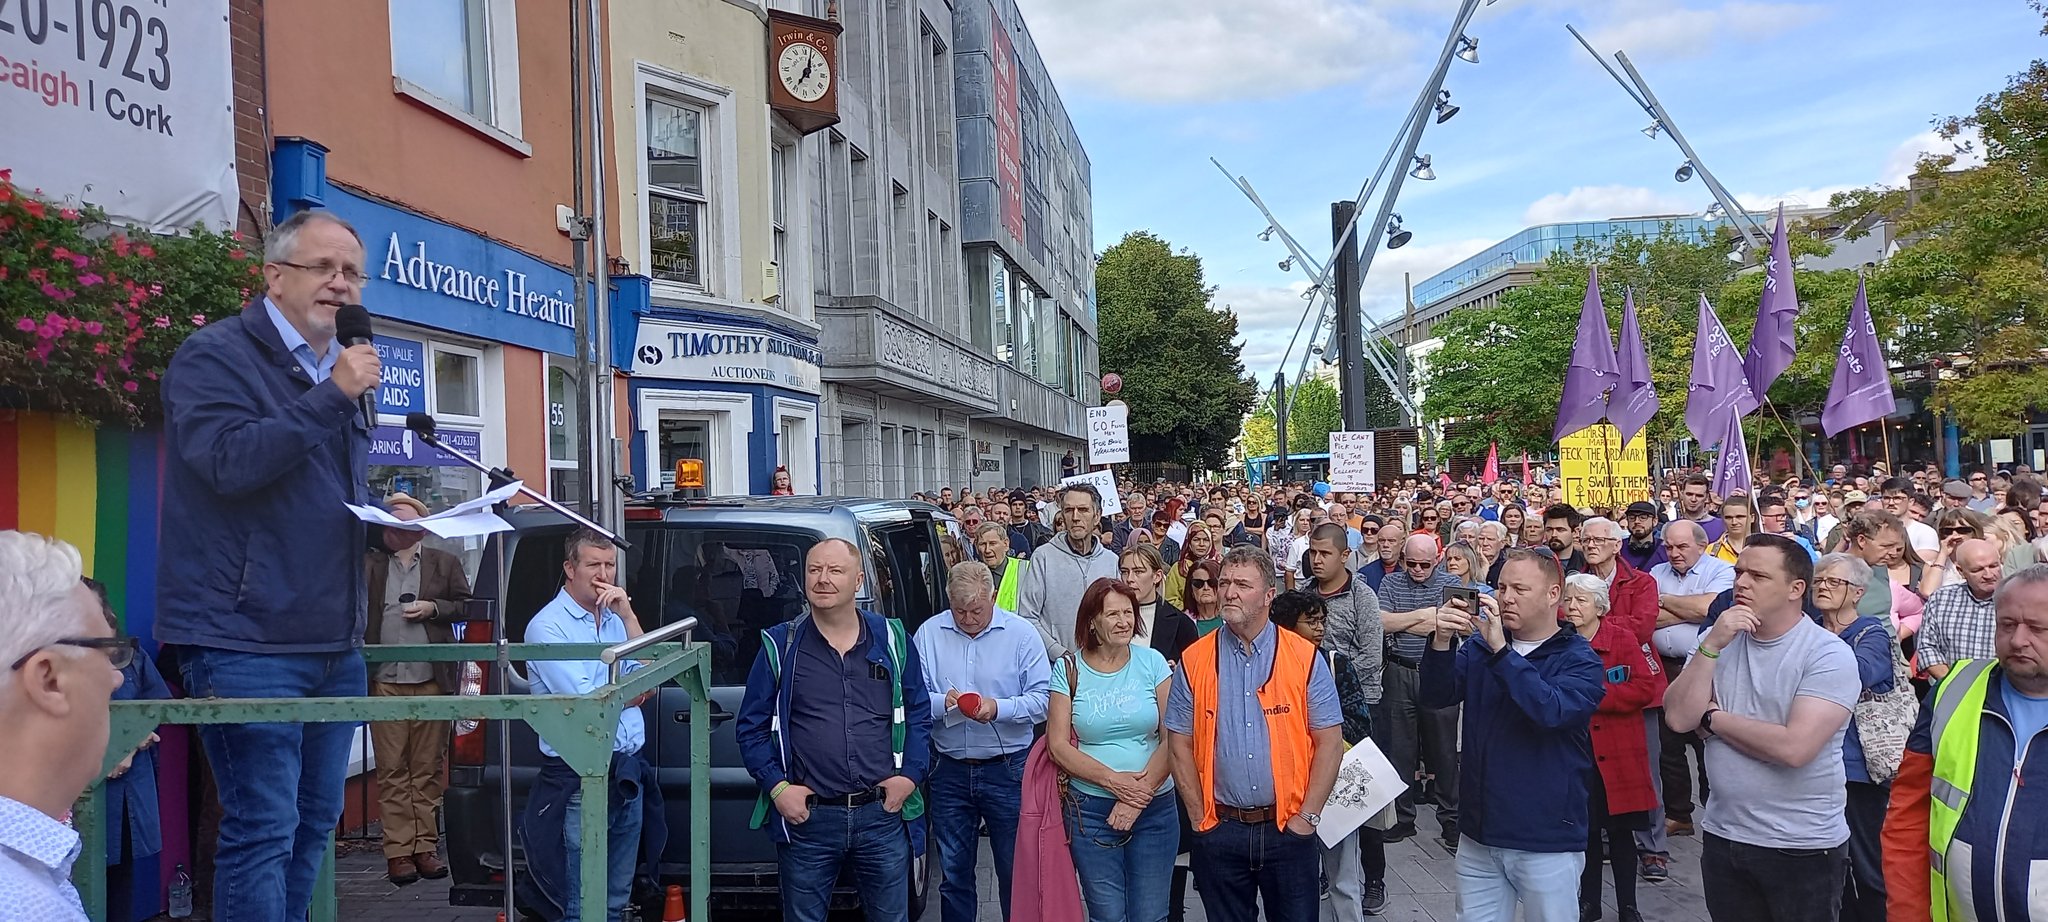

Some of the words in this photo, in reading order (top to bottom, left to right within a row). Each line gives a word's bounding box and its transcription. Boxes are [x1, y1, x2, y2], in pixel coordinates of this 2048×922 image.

[777, 30, 803, 46] Irwin
[806, 33, 815, 43] &
[815, 37, 828, 55] Co.
[105, 88, 173, 137] Cork
[380, 231, 500, 308] Advance
[505, 269, 576, 329] Hearin
[667, 331, 764, 360] TIMOTHY
[391, 346, 414, 362] VALUE
[380, 365, 421, 388] ARING
[711, 366, 776, 382] AUCTIONEERS
[382, 387, 410, 408] AIDS
[551, 402, 565, 427] 55
[1089, 409, 1107, 418] END
[1332, 433, 1348, 442] WE
[369, 440, 401, 455] ARING
[1333, 451, 1345, 460] THE
[1560, 447, 1583, 461] FECK
[1585, 447, 1602, 461] THE
[1621, 476, 1648, 489] THEM
